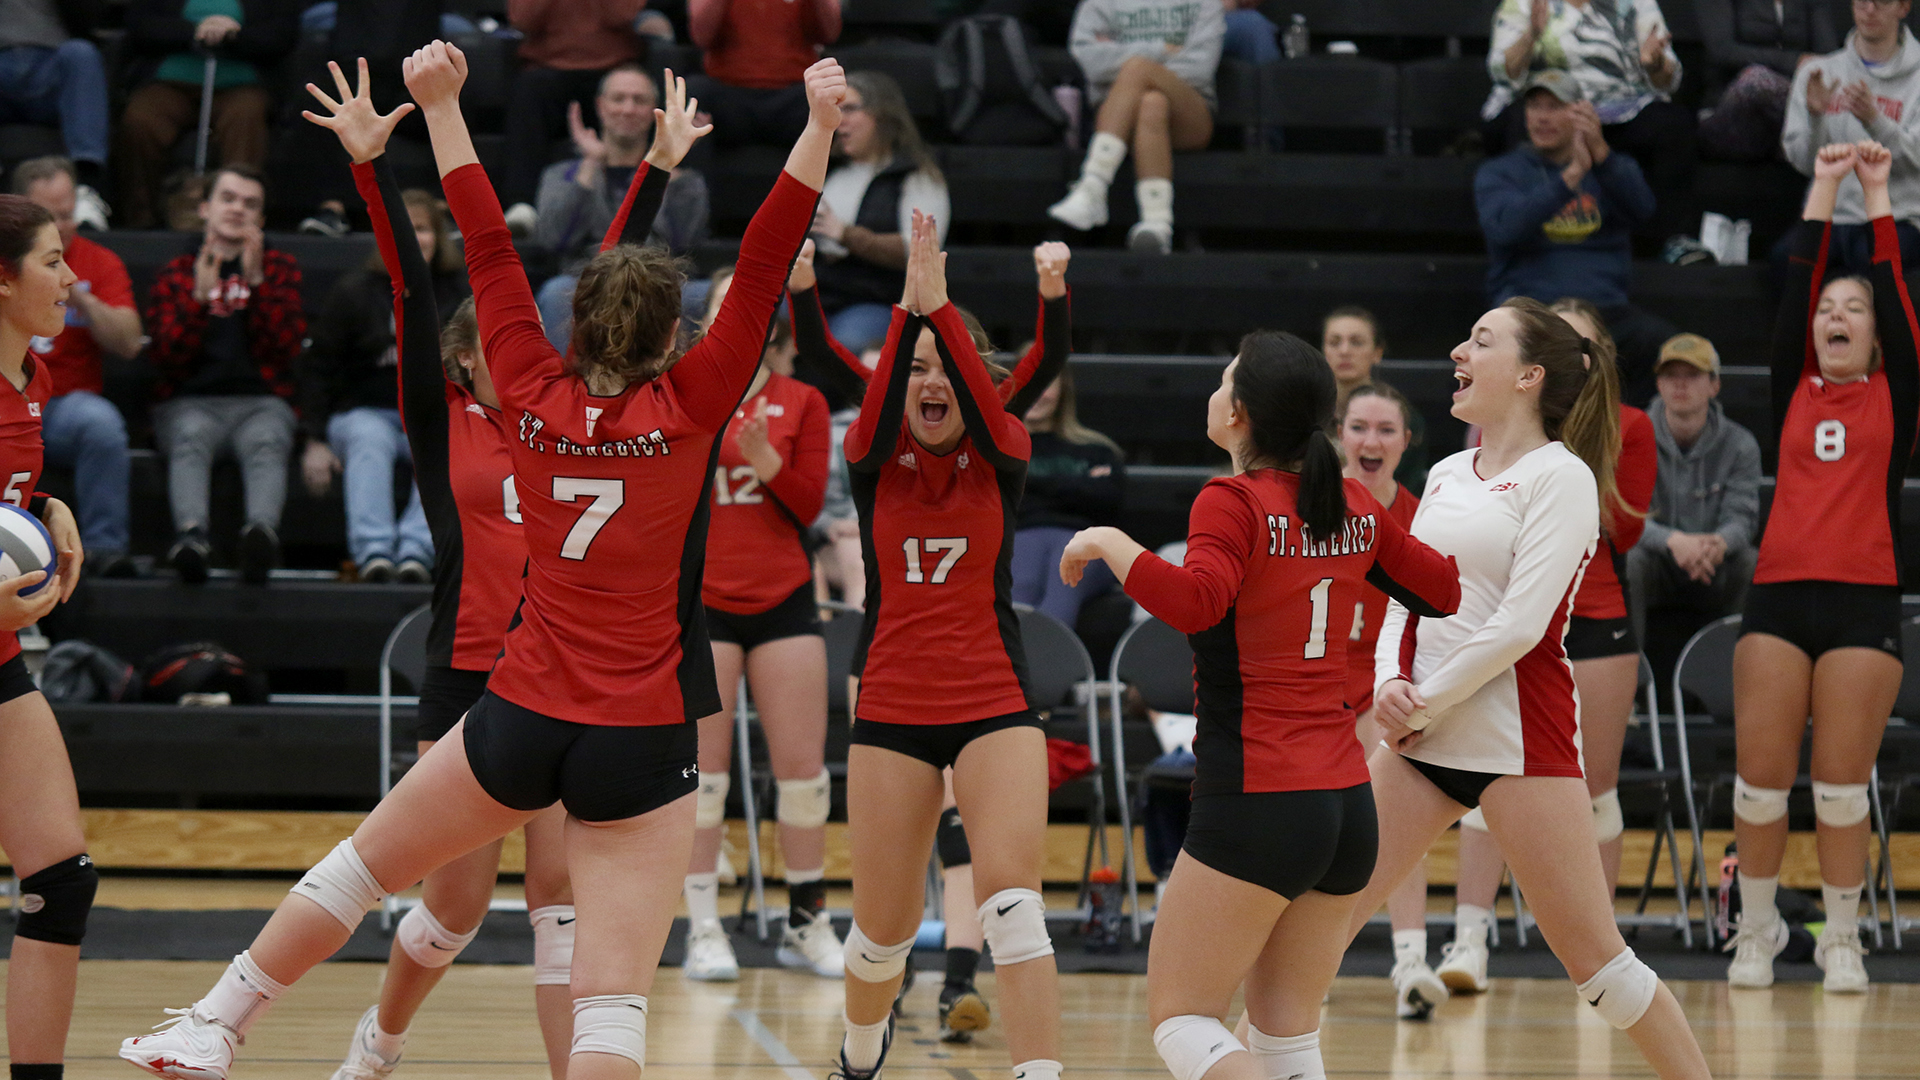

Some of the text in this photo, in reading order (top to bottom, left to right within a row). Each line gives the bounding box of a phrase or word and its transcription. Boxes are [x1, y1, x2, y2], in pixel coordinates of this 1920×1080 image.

[1815, 419, 1846, 462] 8
[716, 465, 764, 505] 12
[552, 475, 625, 562] 7
[1267, 514, 1296, 556] ST.
[902, 536, 968, 584] 17
[1303, 577, 1334, 660] 1
